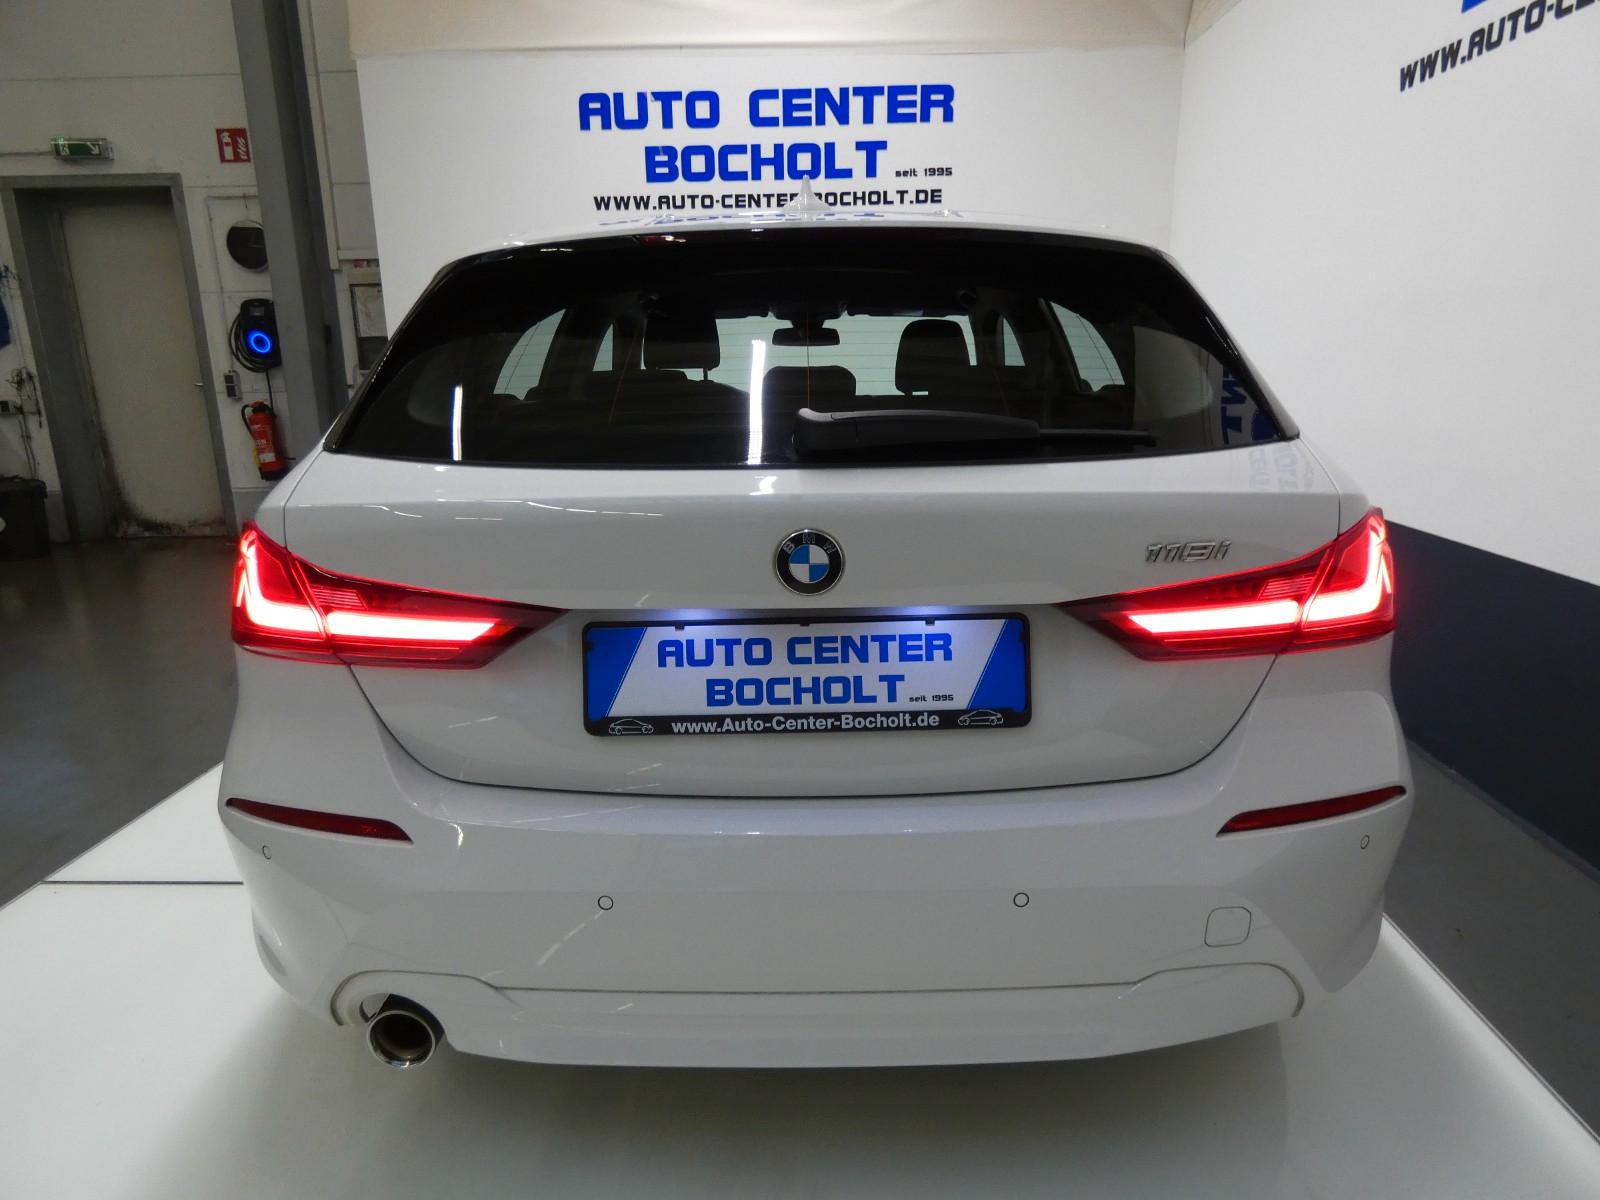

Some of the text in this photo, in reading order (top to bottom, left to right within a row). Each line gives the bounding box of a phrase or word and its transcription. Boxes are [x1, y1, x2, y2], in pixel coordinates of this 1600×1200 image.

[1400, 0, 1600, 92] WWW.AUTO-C
[579, 84, 955, 130] AUTO CENTER
[645, 140, 953, 183] BOCHOLT seit 1995
[594, 188, 943, 212] WWW.AUTO-CENTEOCHOLT.DE
[783, 532, 837, 555] BMW
[1145, 540, 1232, 563] 118i
[657, 632, 952, 668] AUTO CENTER
[706, 674, 955, 707] BOCHOLT seit 1995
[671, 712, 940, 735] www.Auto-Center-Bocholt.de
